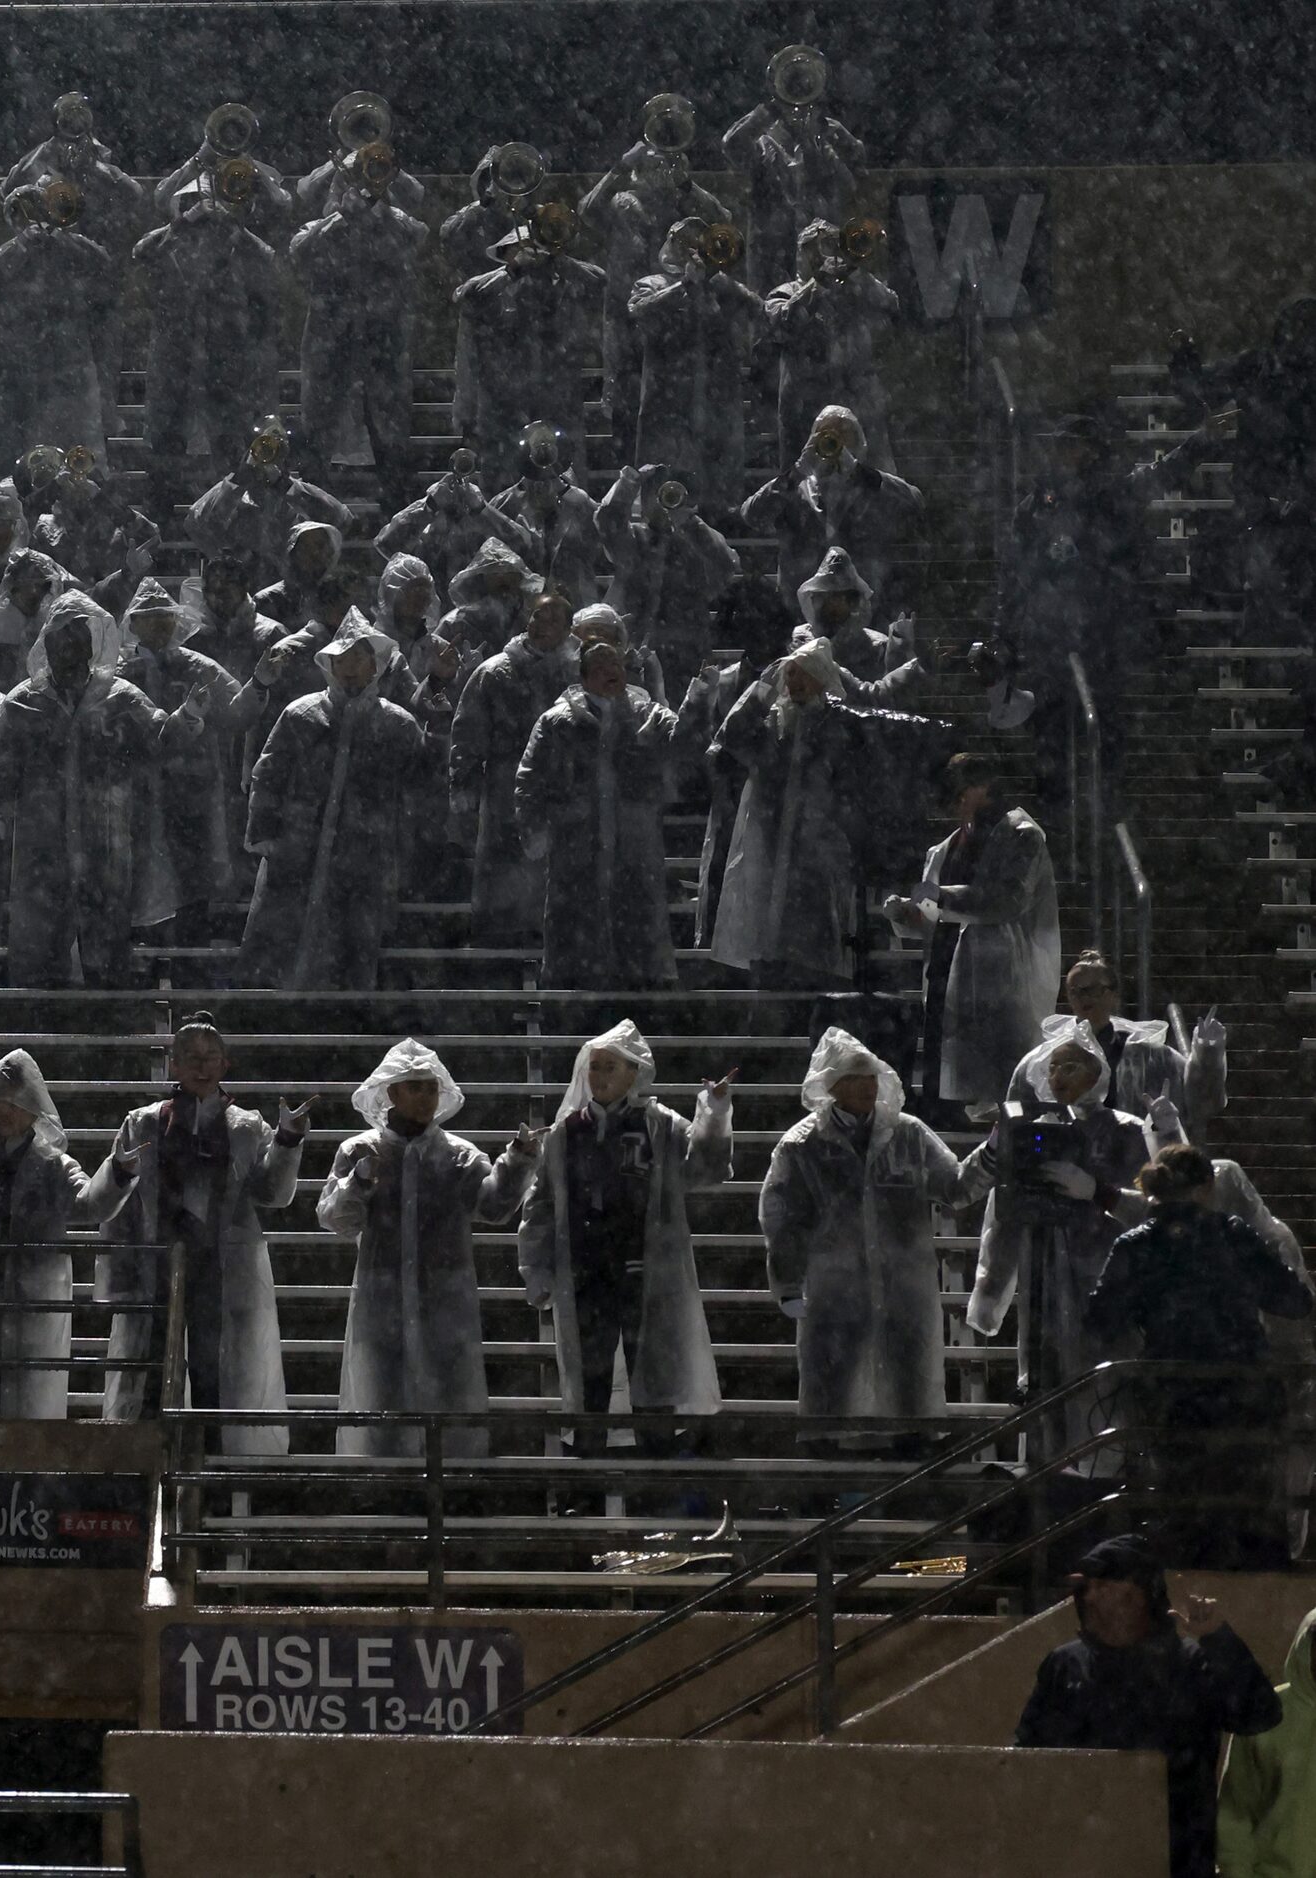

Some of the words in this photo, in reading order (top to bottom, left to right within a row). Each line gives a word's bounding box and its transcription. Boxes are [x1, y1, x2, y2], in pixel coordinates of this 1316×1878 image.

[898, 194, 1045, 319] W
[619, 1131, 651, 1180] L
[64, 1519, 133, 1531] EATERY
[210, 1636, 395, 1689] AISLE
[415, 1639, 474, 1689] W
[215, 1693, 348, 1731] ROWS
[361, 1696, 470, 1732] 13-40
